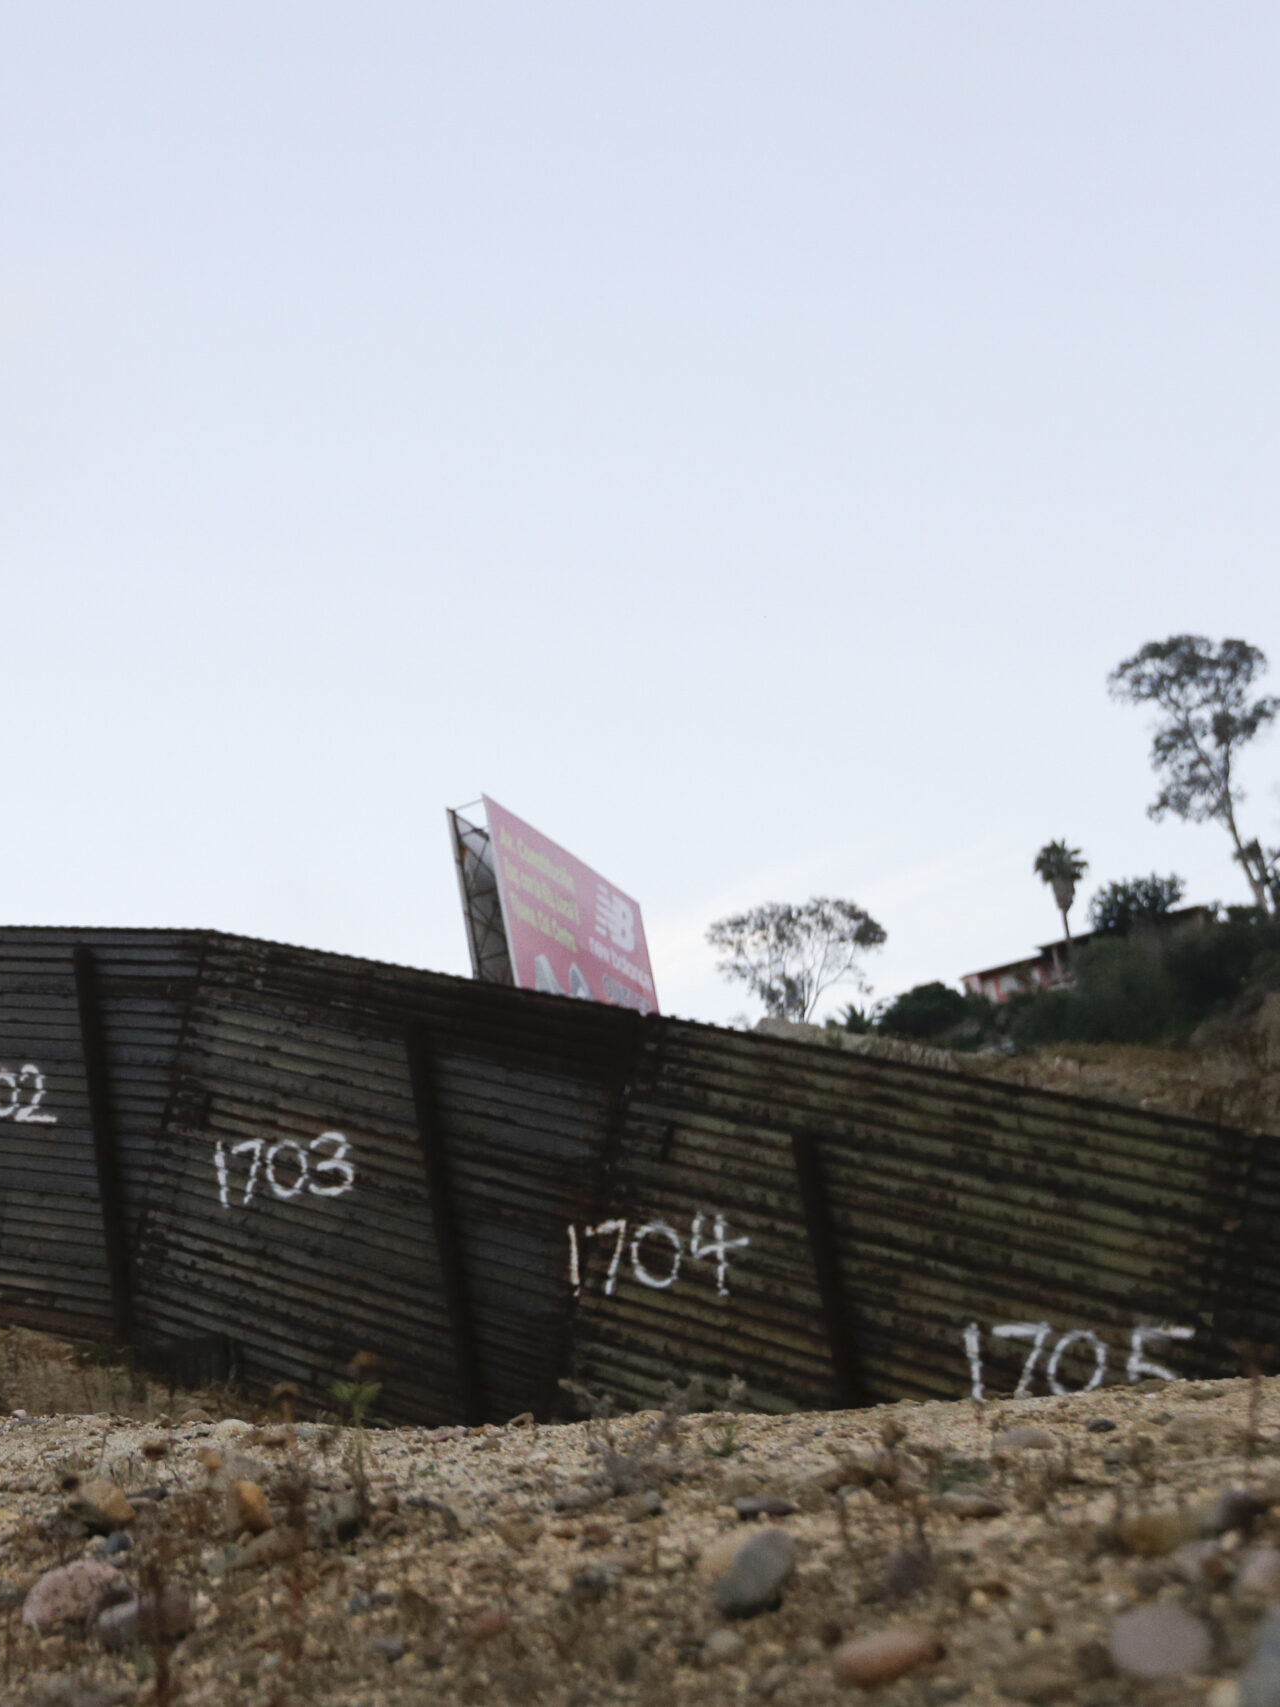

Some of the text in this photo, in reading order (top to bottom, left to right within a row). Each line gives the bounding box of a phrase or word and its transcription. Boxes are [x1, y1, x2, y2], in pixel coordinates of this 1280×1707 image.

[214, 1131, 354, 1208] 1703
[568, 1211, 750, 1296] 1704
[963, 1321, 1196, 1400] 1705
